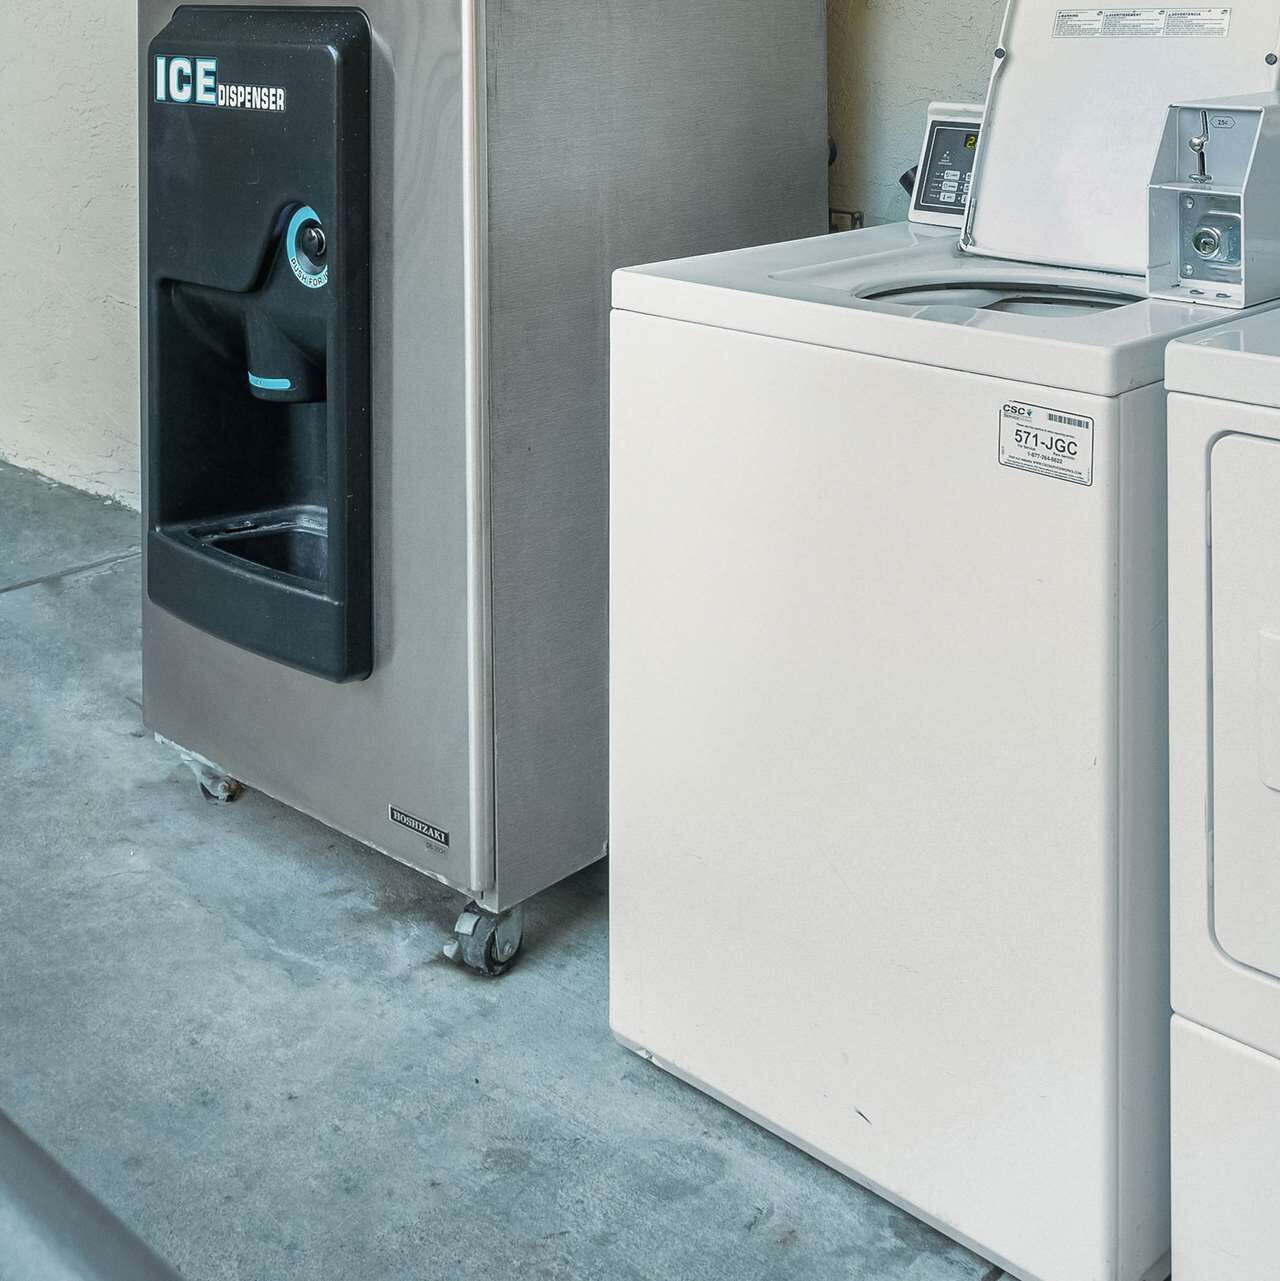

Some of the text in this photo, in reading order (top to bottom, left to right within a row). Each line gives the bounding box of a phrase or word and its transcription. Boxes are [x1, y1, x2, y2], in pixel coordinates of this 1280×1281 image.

[156, 56, 285, 111] ICE DISPENSER
[1003, 404, 1026, 416] CSC
[1014, 428, 1078, 456] 571-JGC
[392, 810, 446, 843] HOSHIZAKI
